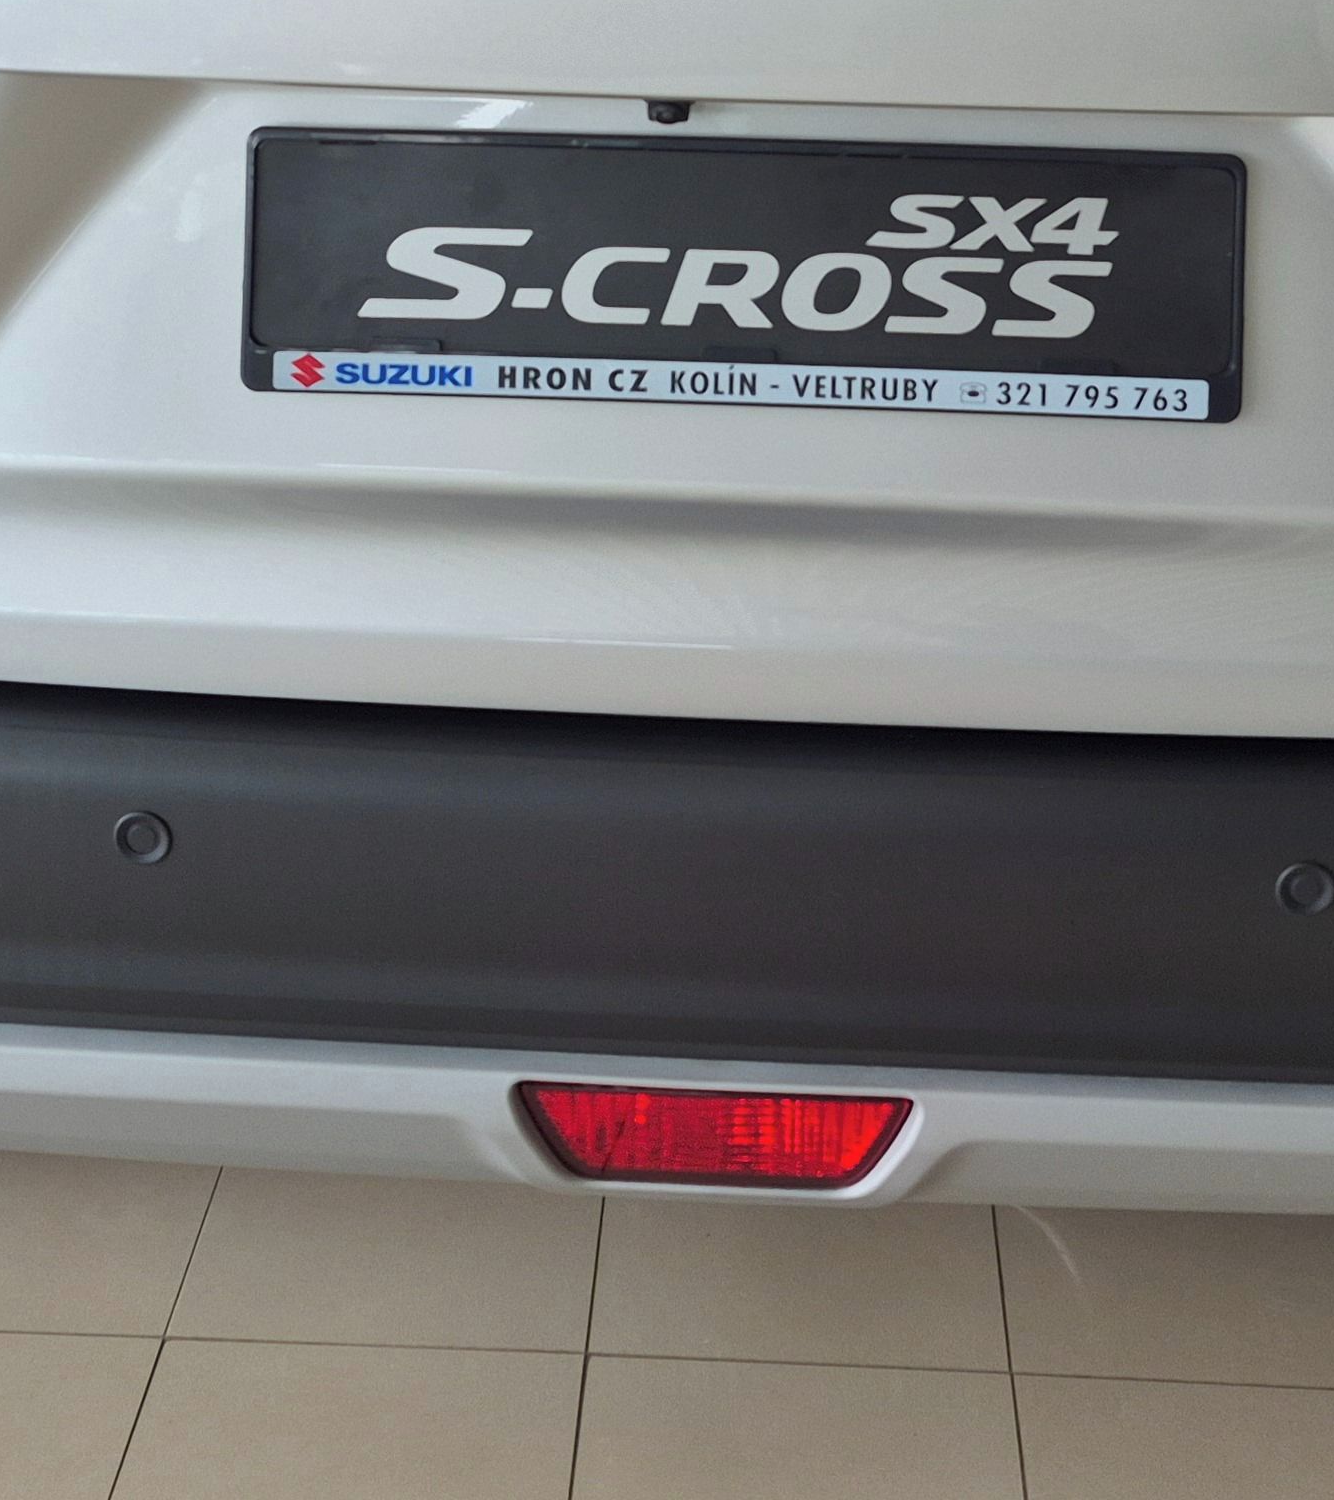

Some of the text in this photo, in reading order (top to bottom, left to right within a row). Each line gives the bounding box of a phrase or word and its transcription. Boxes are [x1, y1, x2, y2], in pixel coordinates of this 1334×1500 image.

[865, 194, 1120, 256] SX4
[357, 226, 1113, 339] S-CROSS
[334, 361, 474, 389] SUZUKI
[497, 365, 592, 391] HRON
[607, 368, 649, 393] CZ
[670, 364, 757, 396] KOLÍN
[792, 374, 940, 402] VELTRUBY
[995, 381, 1047, 407] 321
[1065, 384, 1119, 410] 795
[1134, 386, 1189, 412] 763
